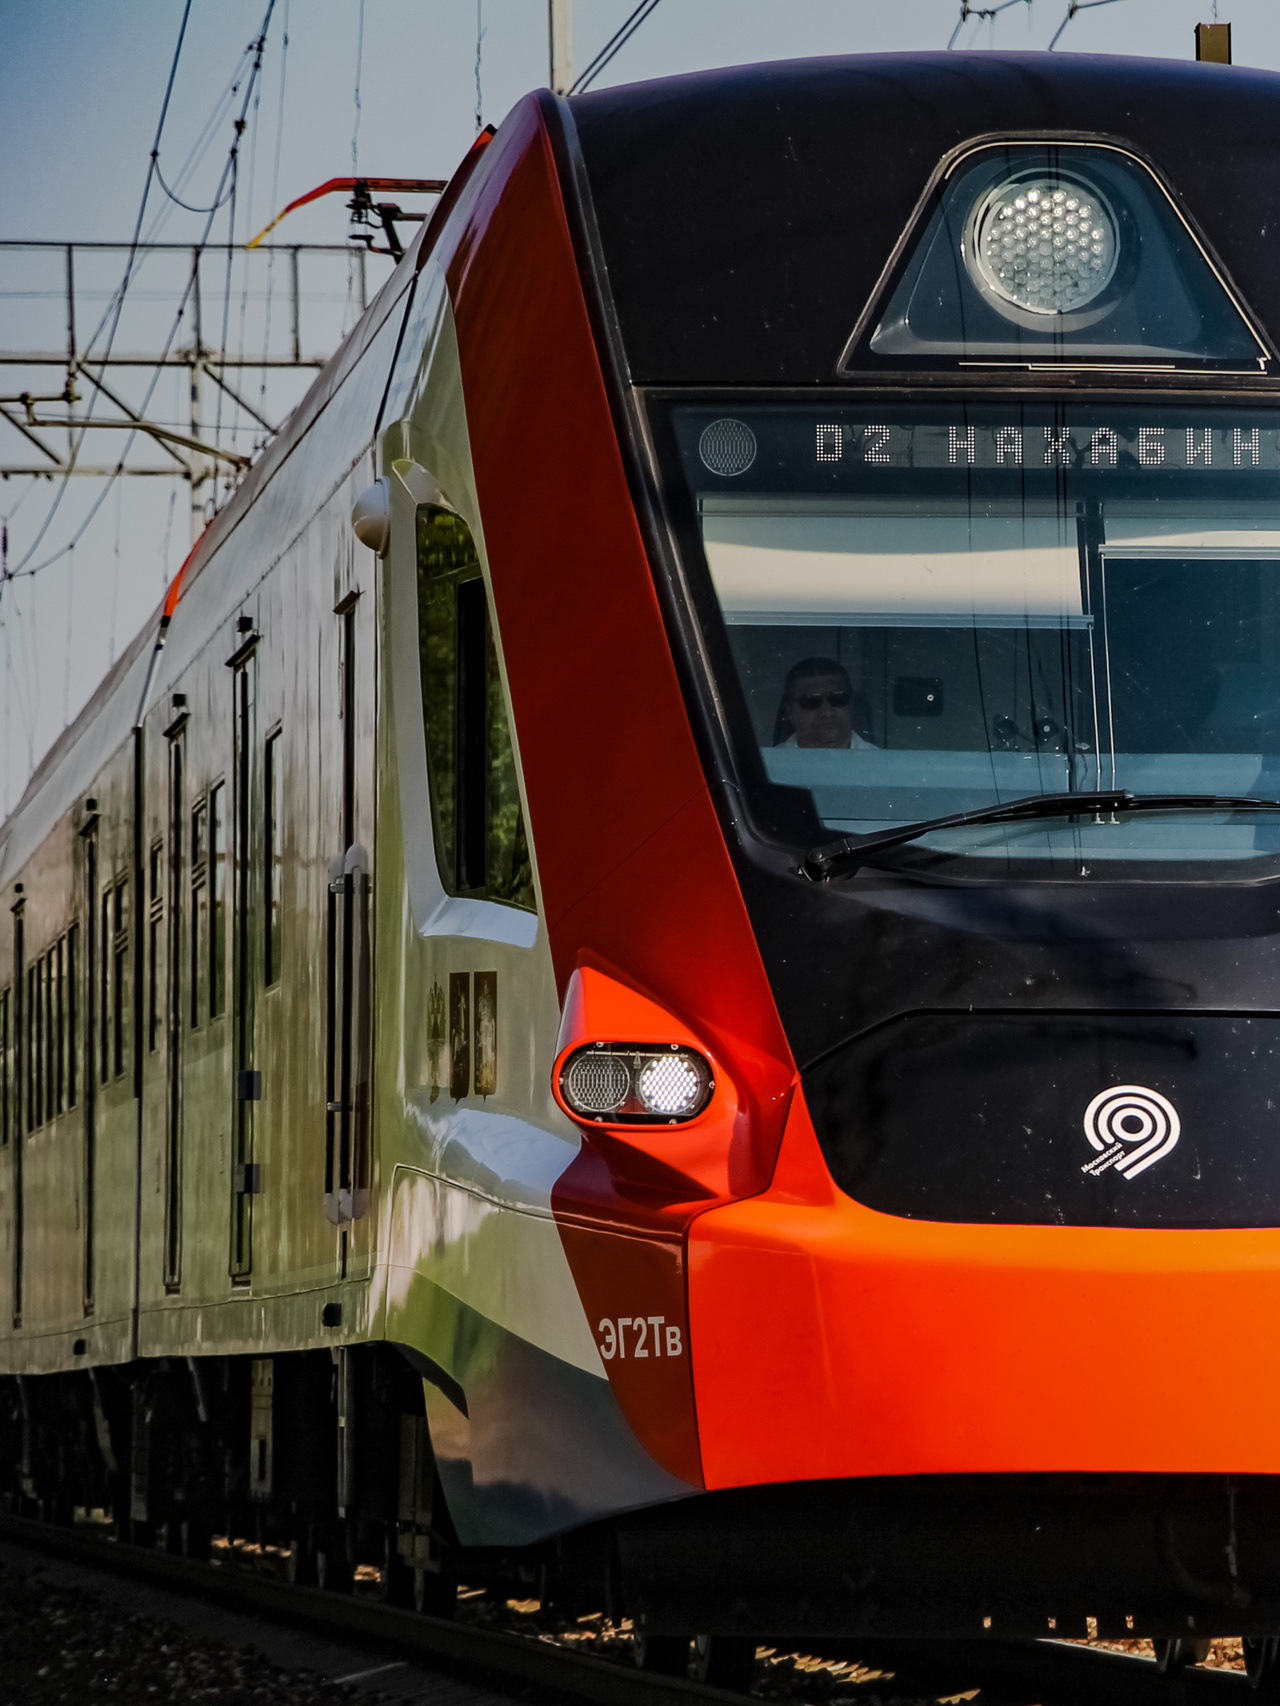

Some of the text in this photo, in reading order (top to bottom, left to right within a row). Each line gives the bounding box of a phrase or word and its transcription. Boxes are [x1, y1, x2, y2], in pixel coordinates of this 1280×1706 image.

[816, 424, 890, 462] D2
[1081, 1141, 1123, 1173] Московский
[1089, 1150, 1125, 1176] Транспорт
[598, 1316, 683, 1360] ЭГ2Тв
